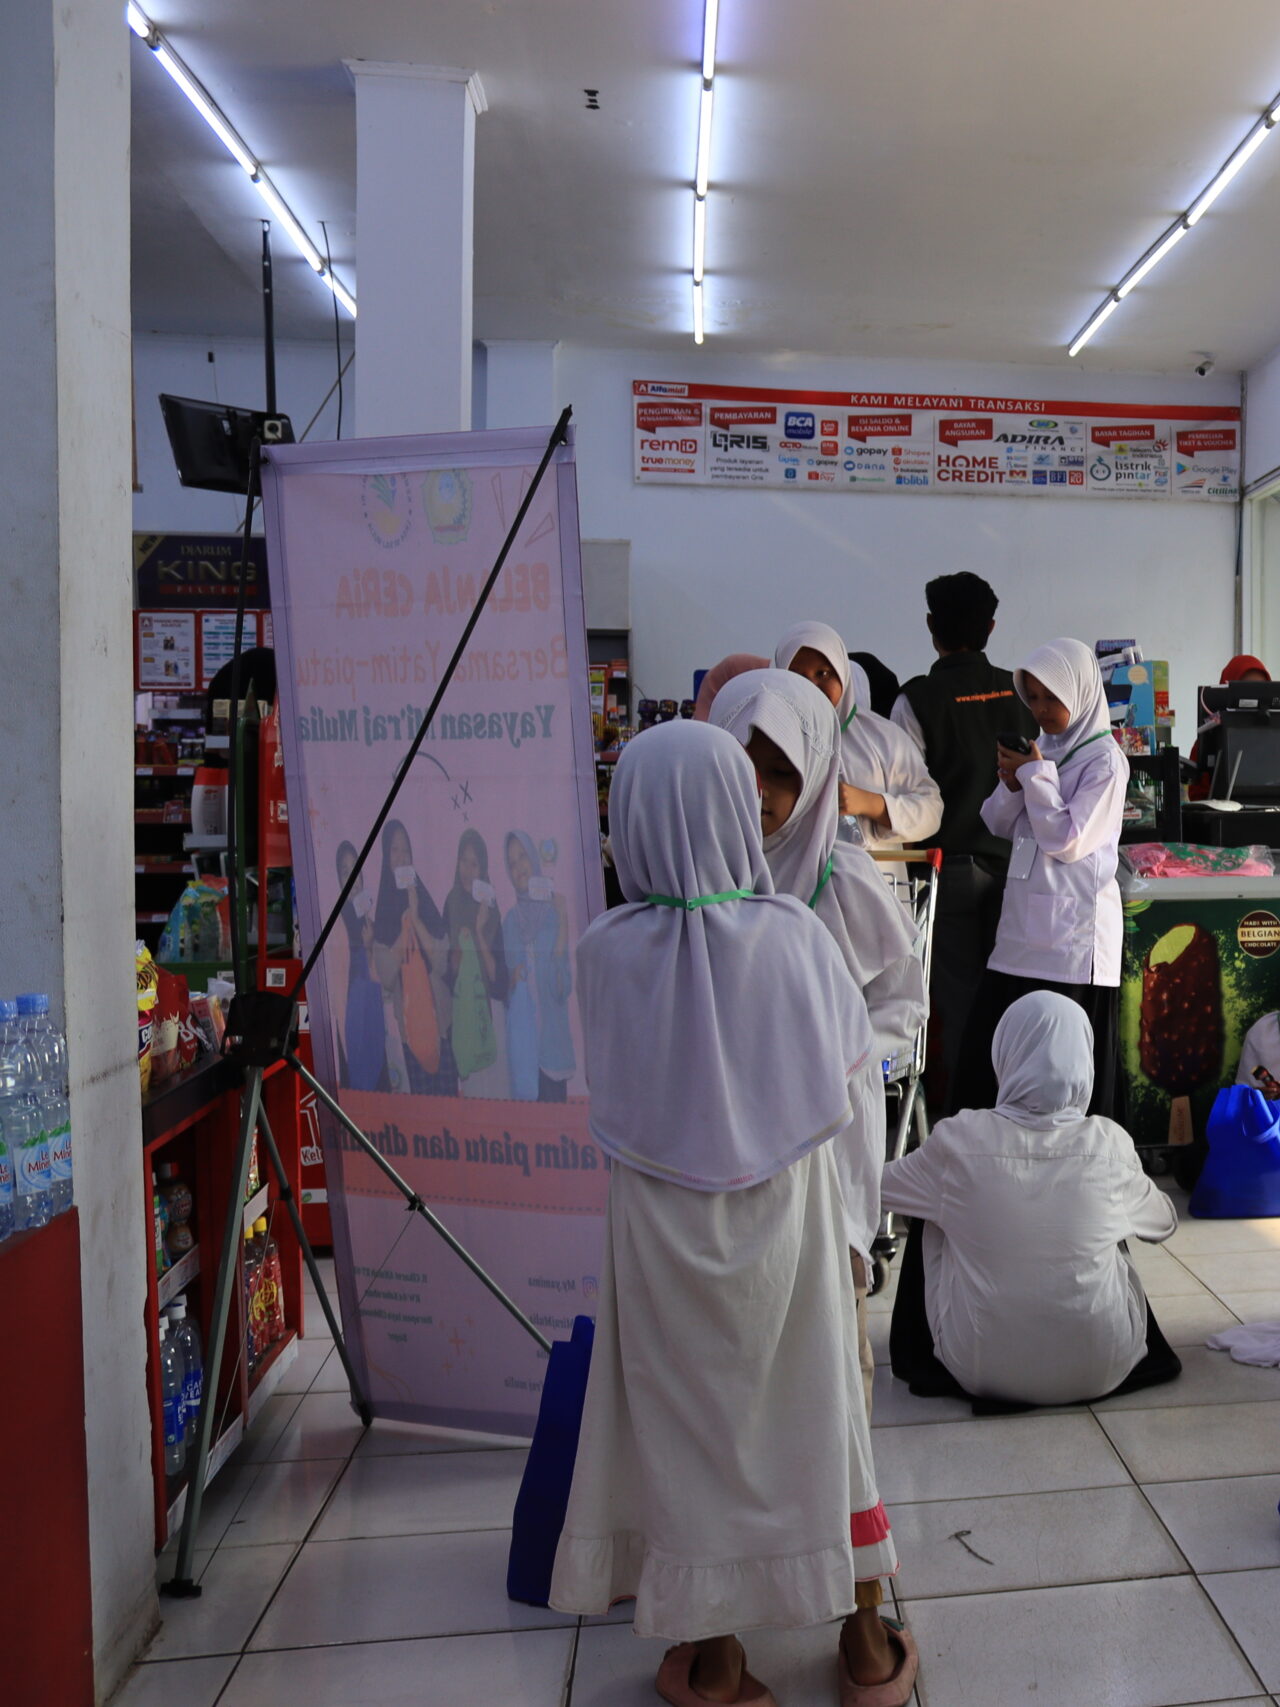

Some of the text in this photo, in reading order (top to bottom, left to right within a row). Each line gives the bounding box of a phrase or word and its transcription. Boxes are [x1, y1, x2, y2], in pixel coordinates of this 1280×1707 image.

[851, 395, 1045, 412] KAMI MELAYANI TRANSAKSI
[639, 407, 687, 415] PENGIRIMAN
[788, 416, 812, 427] BCA
[711, 432, 770, 452] QRIS
[994, 433, 1066, 445] ADIRA
[856, 447, 888, 456] gopay
[937, 455, 999, 469] HOME
[1115, 461, 1151, 471] listrik
[1192, 466, 1237, 475] Google Play
[902, 475, 929, 486] blibli
[937, 469, 1006, 484] CREDIT
[1115, 472, 1151, 481] pintar
[157, 560, 257, 581] KING
[1241, 930, 1280, 938] BELGIAN
